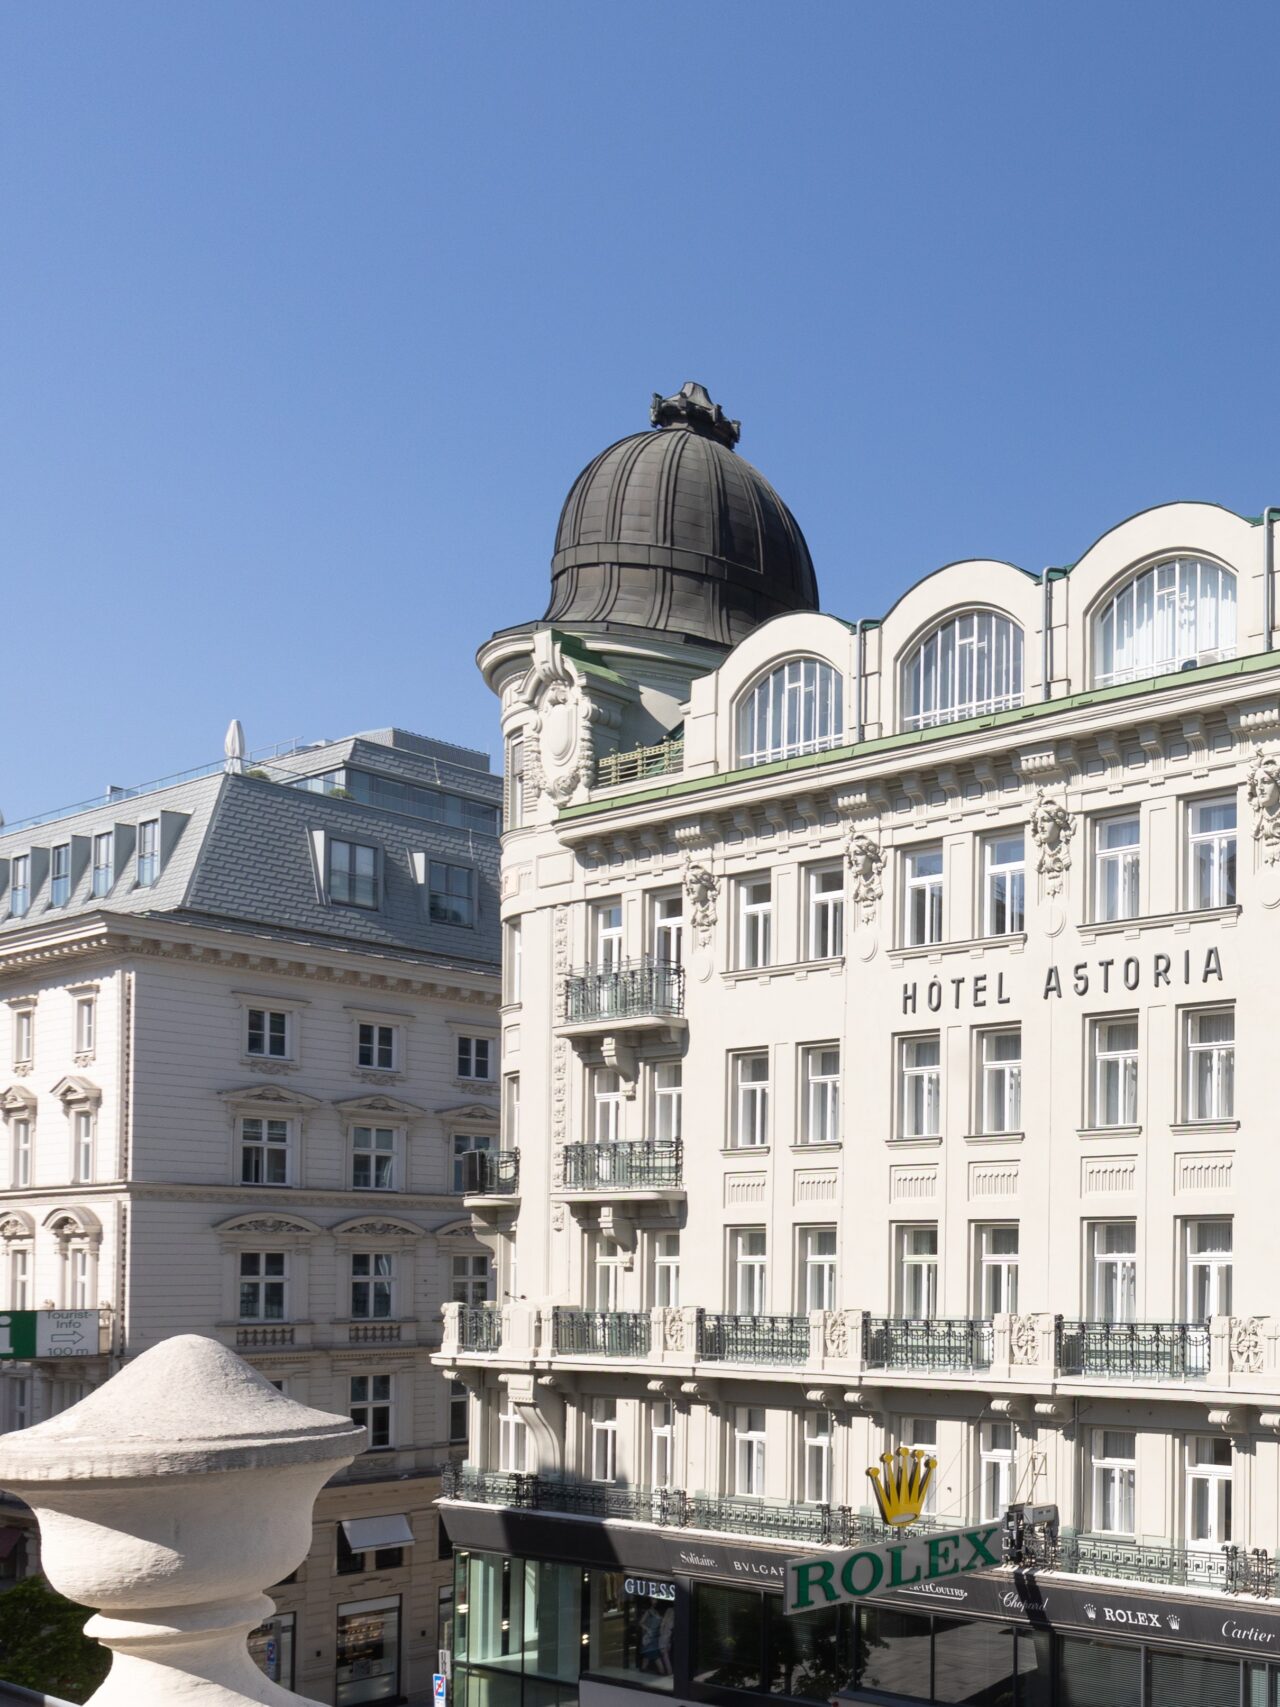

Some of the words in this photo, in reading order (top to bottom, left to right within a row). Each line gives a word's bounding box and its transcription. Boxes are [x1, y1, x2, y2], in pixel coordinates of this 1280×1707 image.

[1043, 946, 1223, 1000] ASTORIA
[56, 1320, 82, 1329] Info
[47, 1347, 73, 1356] 100
[76, 1348, 89, 1356] m
[792, 1527, 1003, 1608] ROLEX
[624, 1578, 676, 1600] GUESS
[998, 1591, 1049, 1613] Chopard
[1103, 1607, 1162, 1628] ROLEX
[1221, 1620, 1275, 1643] Cartier
